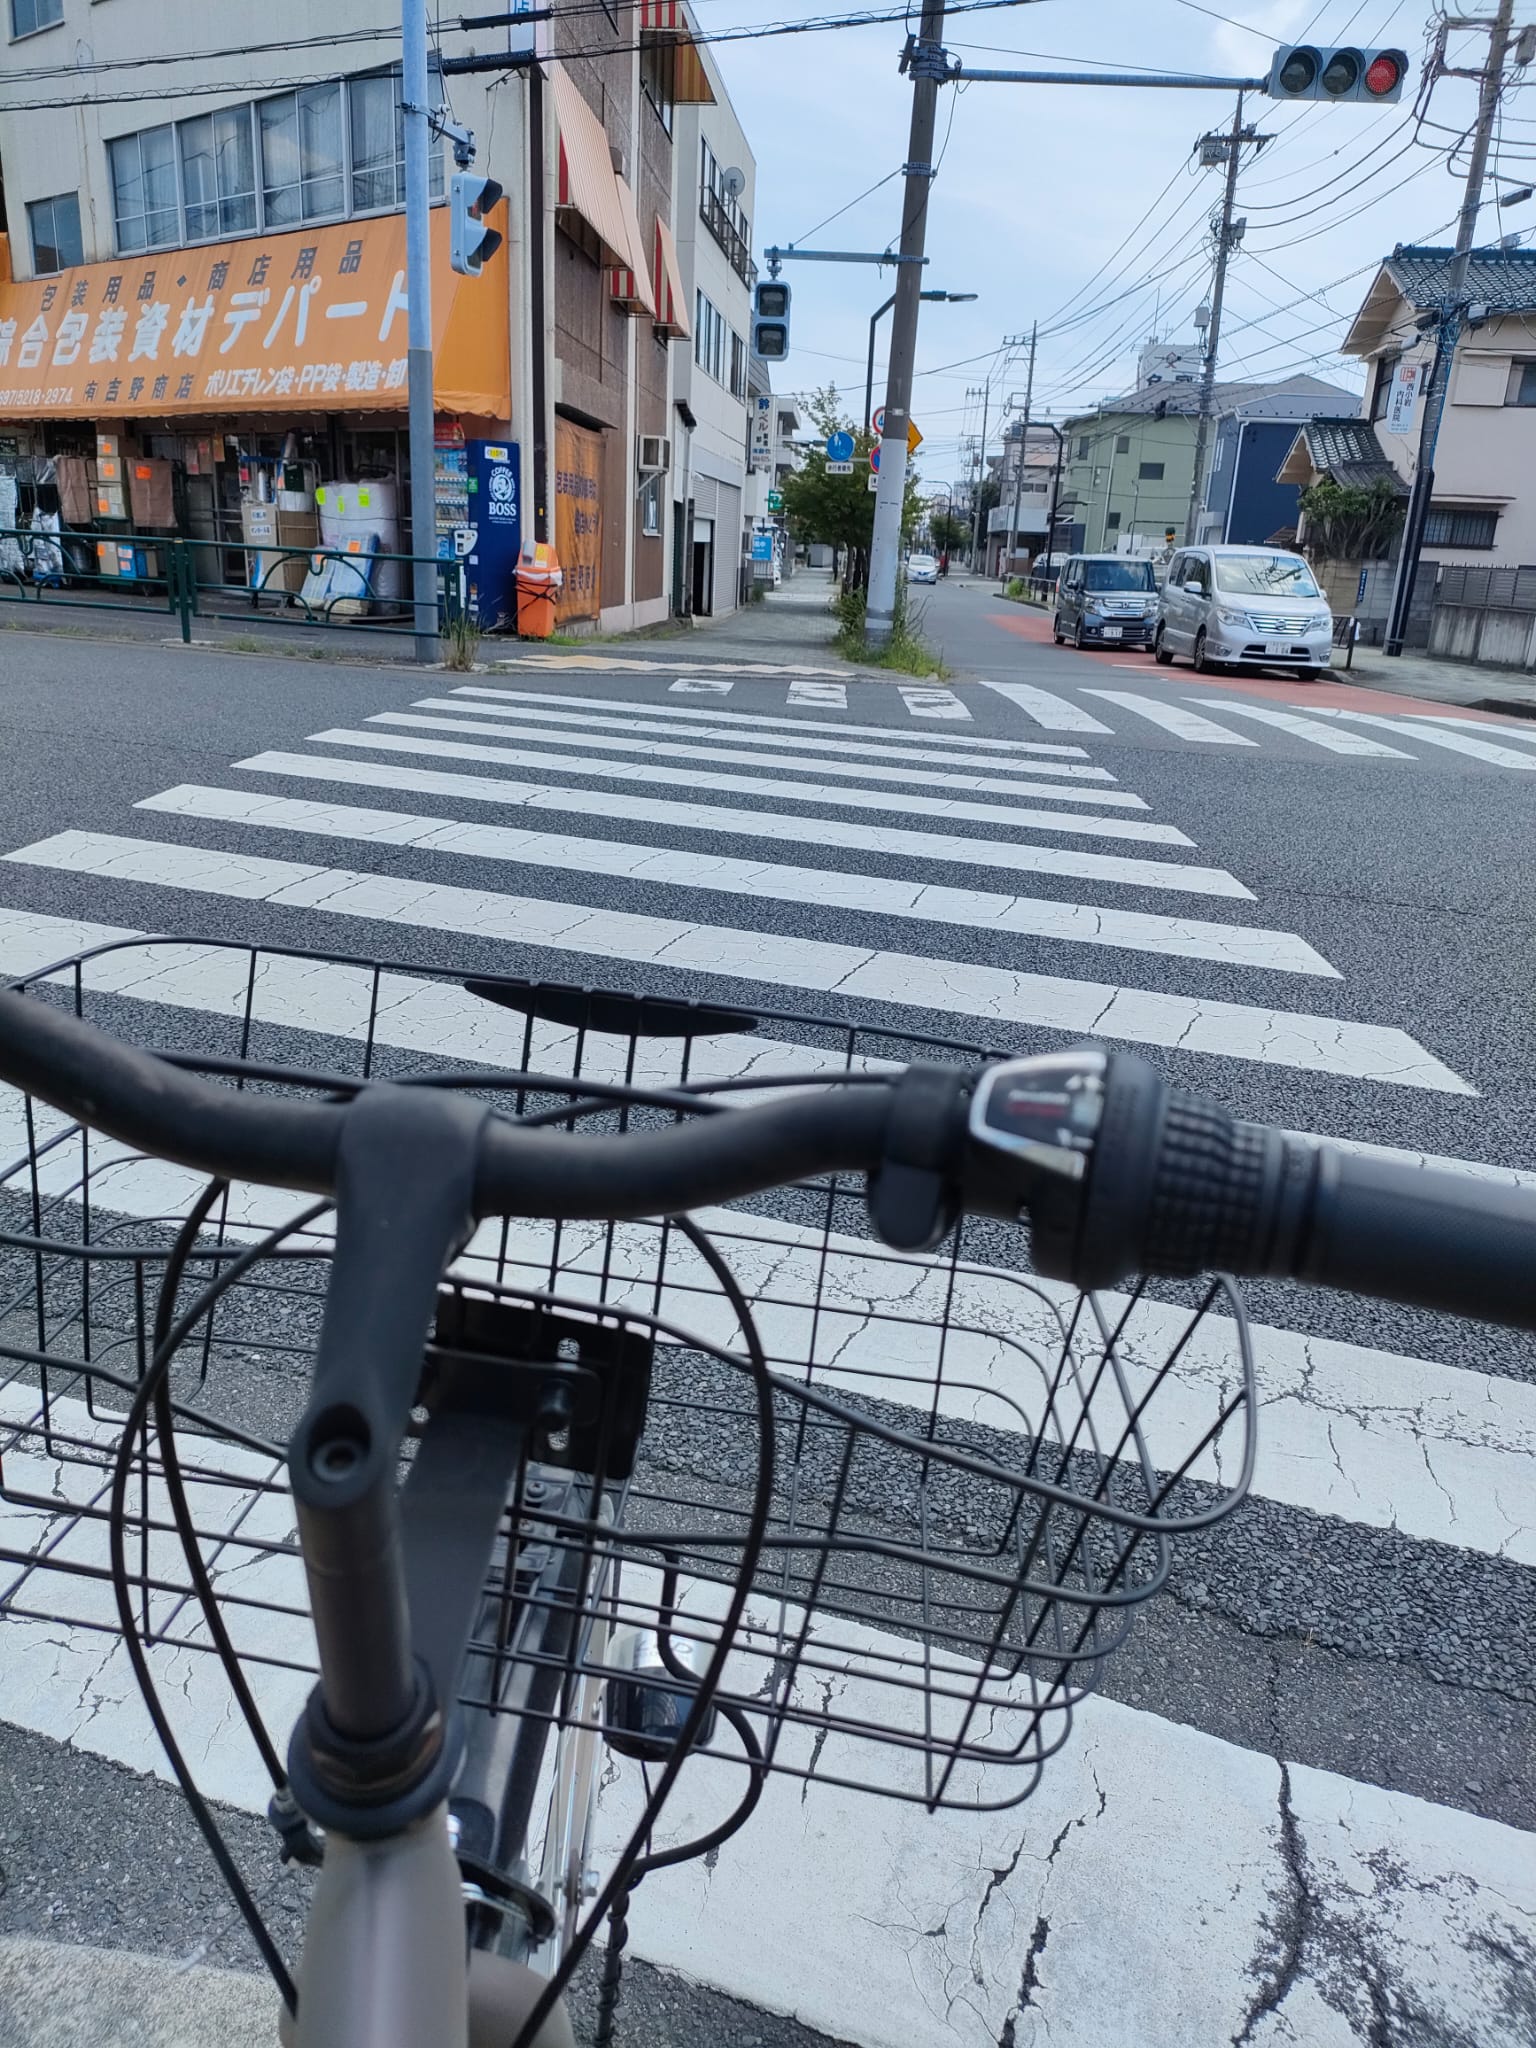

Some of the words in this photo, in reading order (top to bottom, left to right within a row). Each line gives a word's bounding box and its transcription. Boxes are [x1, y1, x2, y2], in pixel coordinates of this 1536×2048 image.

[41, 271, 156, 312] 包装用品
[207, 240, 363, 291] 商店用品
[491, 466, 513, 477] COFFEE
[488, 502, 517, 517] BOSS
